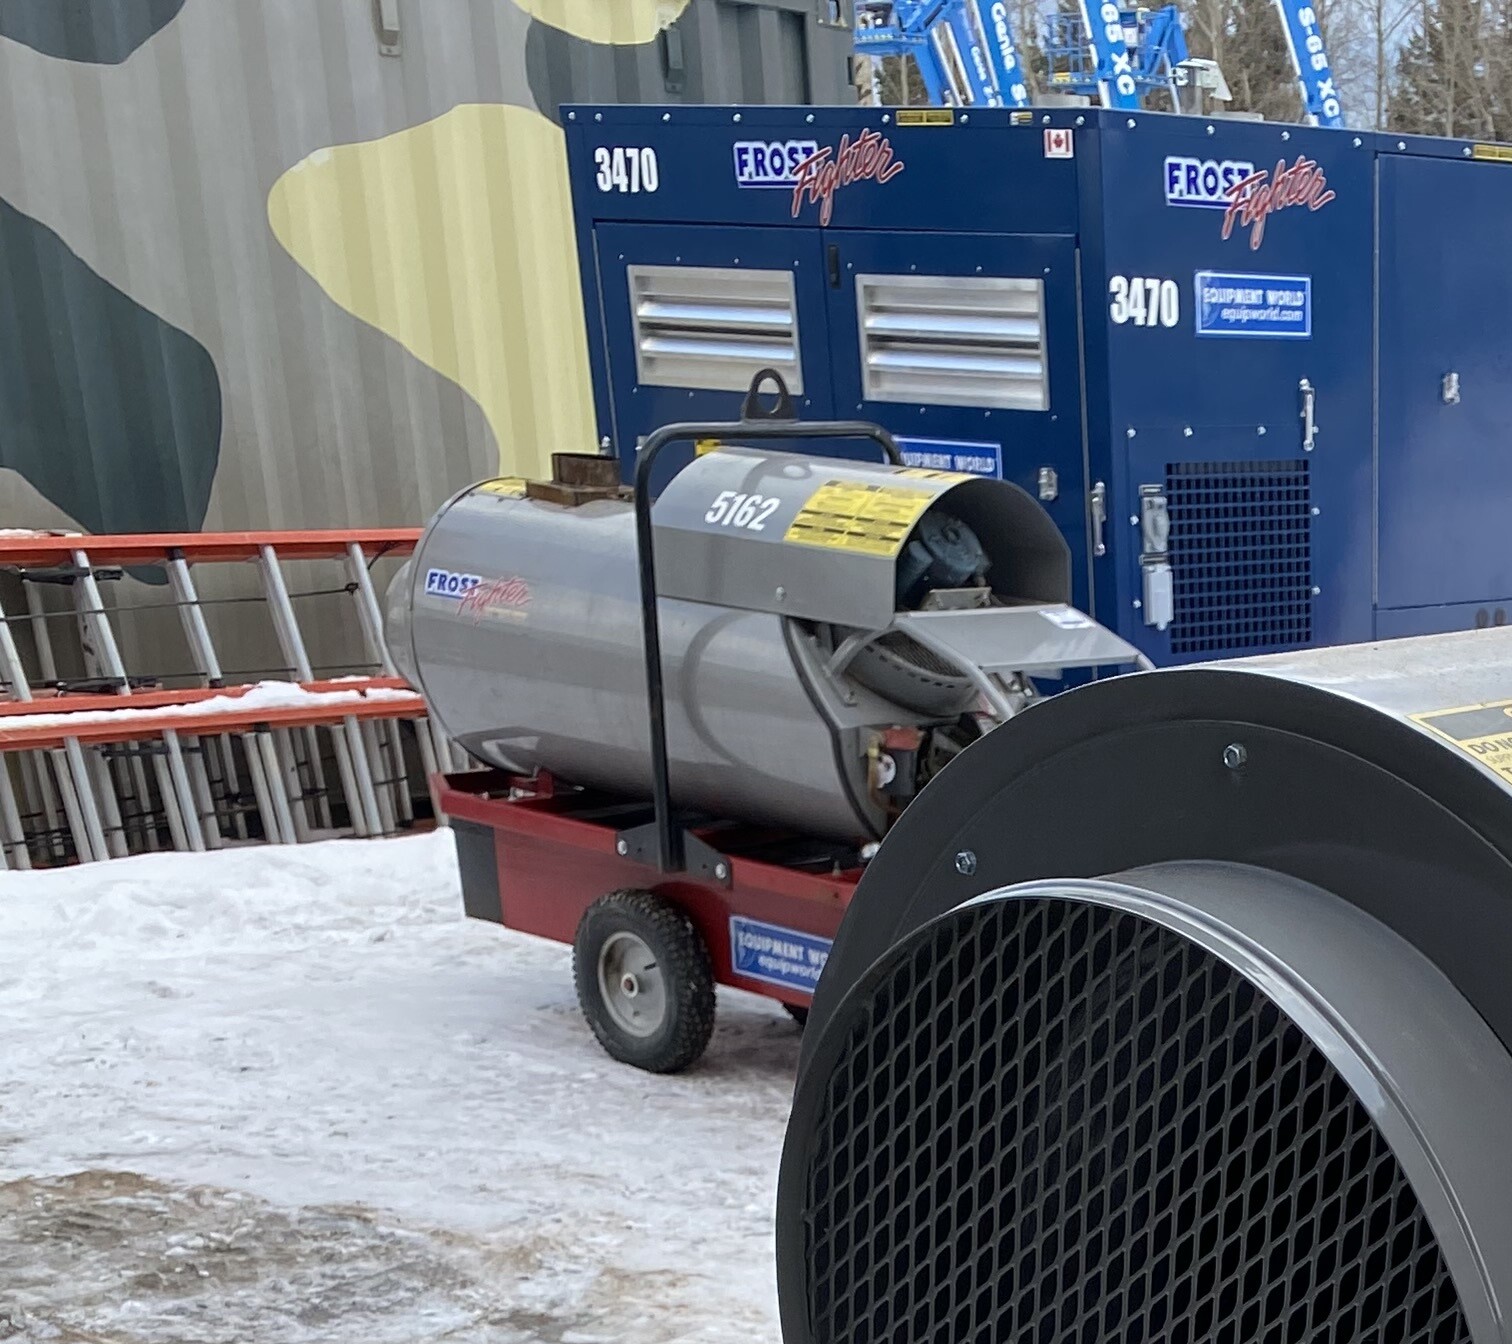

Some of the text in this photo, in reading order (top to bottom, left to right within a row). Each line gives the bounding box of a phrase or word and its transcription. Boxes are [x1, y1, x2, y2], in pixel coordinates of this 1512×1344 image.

[594, 147, 660, 193] 3470
[737, 127, 904, 227] FROST Fighter
[1167, 154, 1336, 250] FROST Fighter
[1109, 275, 1179, 328] 3470
[1203, 287, 1305, 306] EQUIPMENT WORLD
[704, 490, 781, 532] 5162
[427, 571, 480, 596] FROST
[1465, 741, 1502, 754] DO
